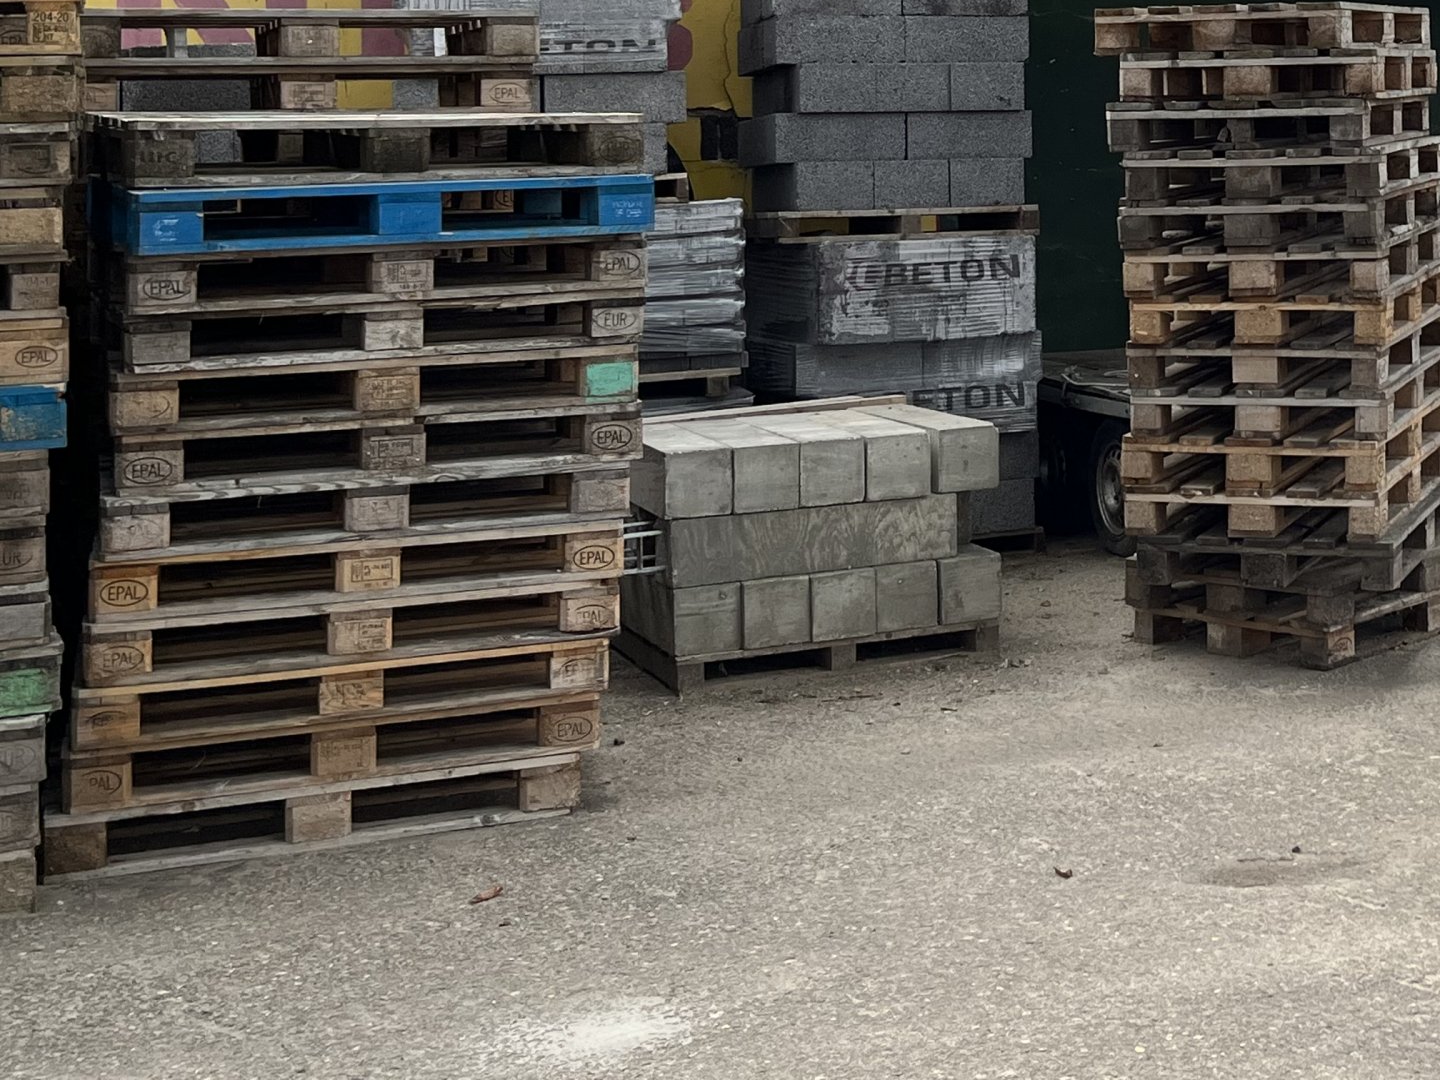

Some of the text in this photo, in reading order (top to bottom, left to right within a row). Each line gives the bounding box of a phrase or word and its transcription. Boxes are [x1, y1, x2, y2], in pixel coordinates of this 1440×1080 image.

[494, 87, 521, 100] EPAL
[605, 256, 634, 270] EPAL
[151, 280, 185, 295] EPAL
[604, 313, 627, 327] EUR
[21, 350, 50, 364] EPAL
[597, 425, 627, 445] EPAL
[132, 463, 165, 479] EPAL
[579, 549, 609, 566] EPAL
[108, 584, 142, 602] EPAL
[103, 651, 136, 669] EPAL
[557, 720, 588, 738] EPAL
[88, 775, 115, 792] PAL
